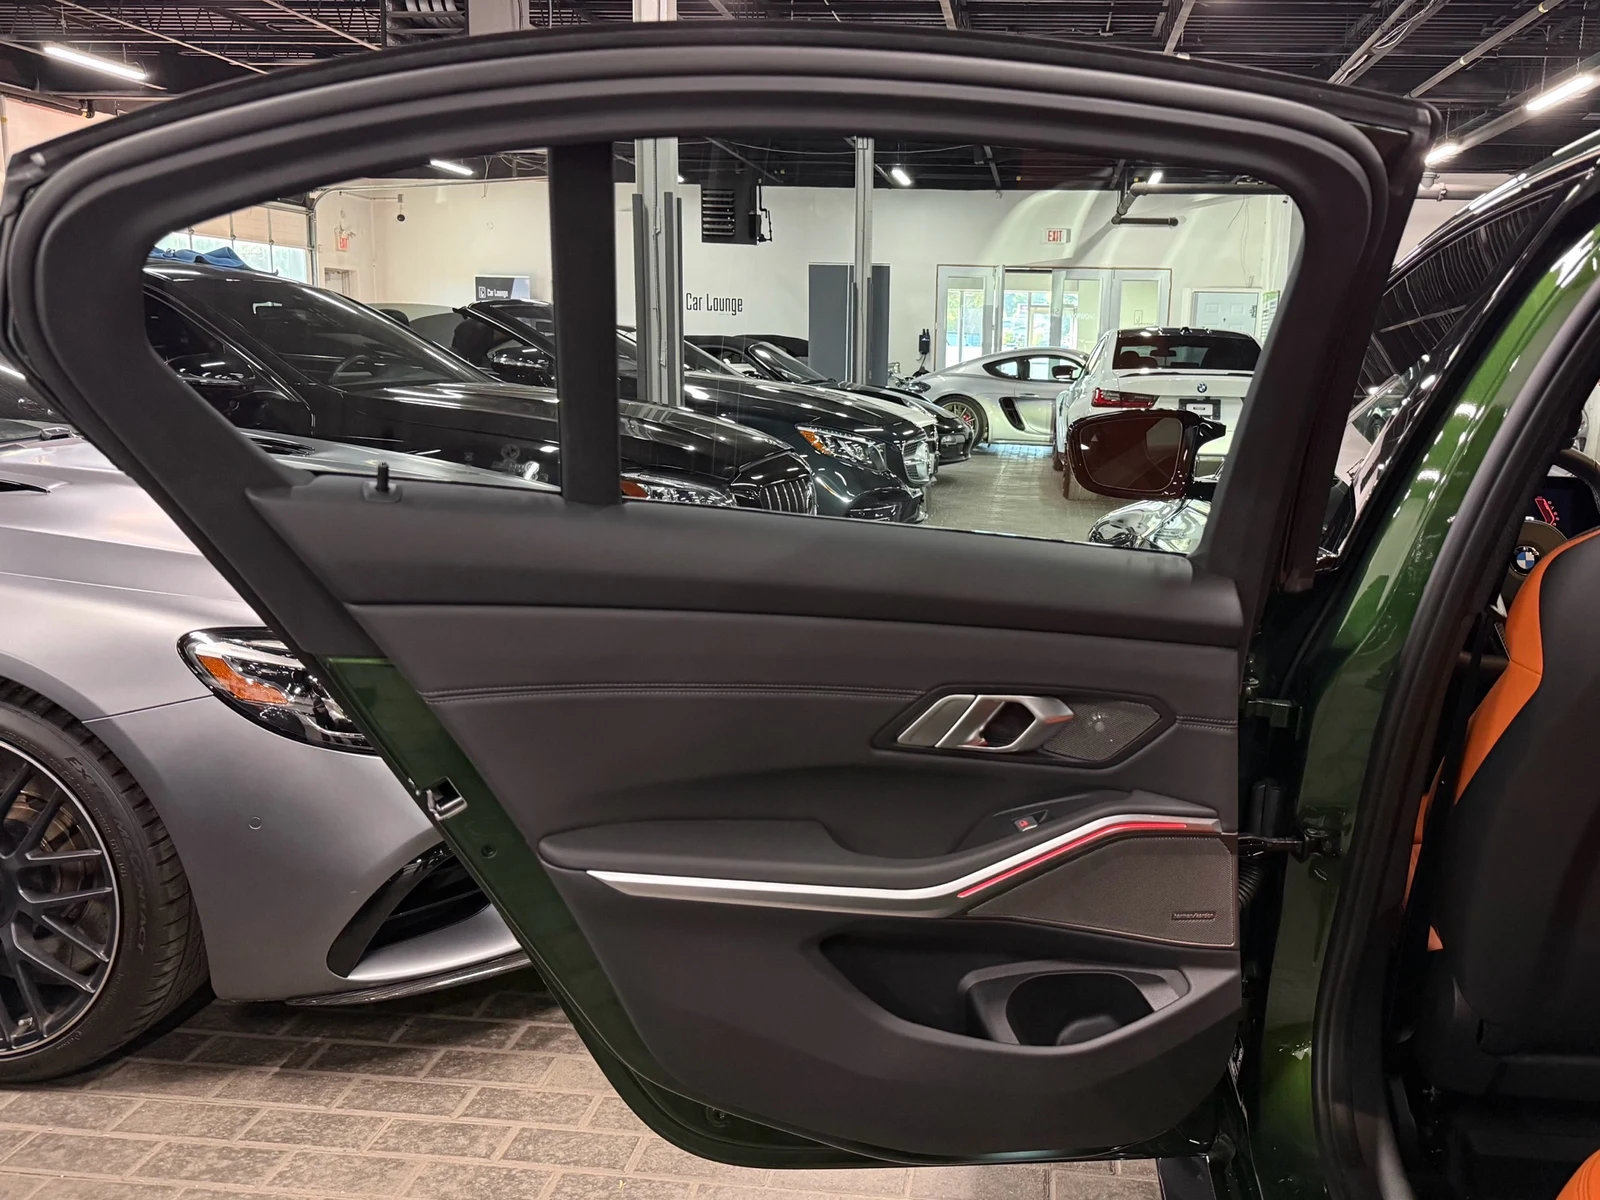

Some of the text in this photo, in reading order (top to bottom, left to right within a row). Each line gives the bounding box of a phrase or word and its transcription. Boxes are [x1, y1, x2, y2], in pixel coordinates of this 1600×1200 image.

[1048, 230, 1062, 242] EXIT
[686, 292, 743, 316] Car Lounge
